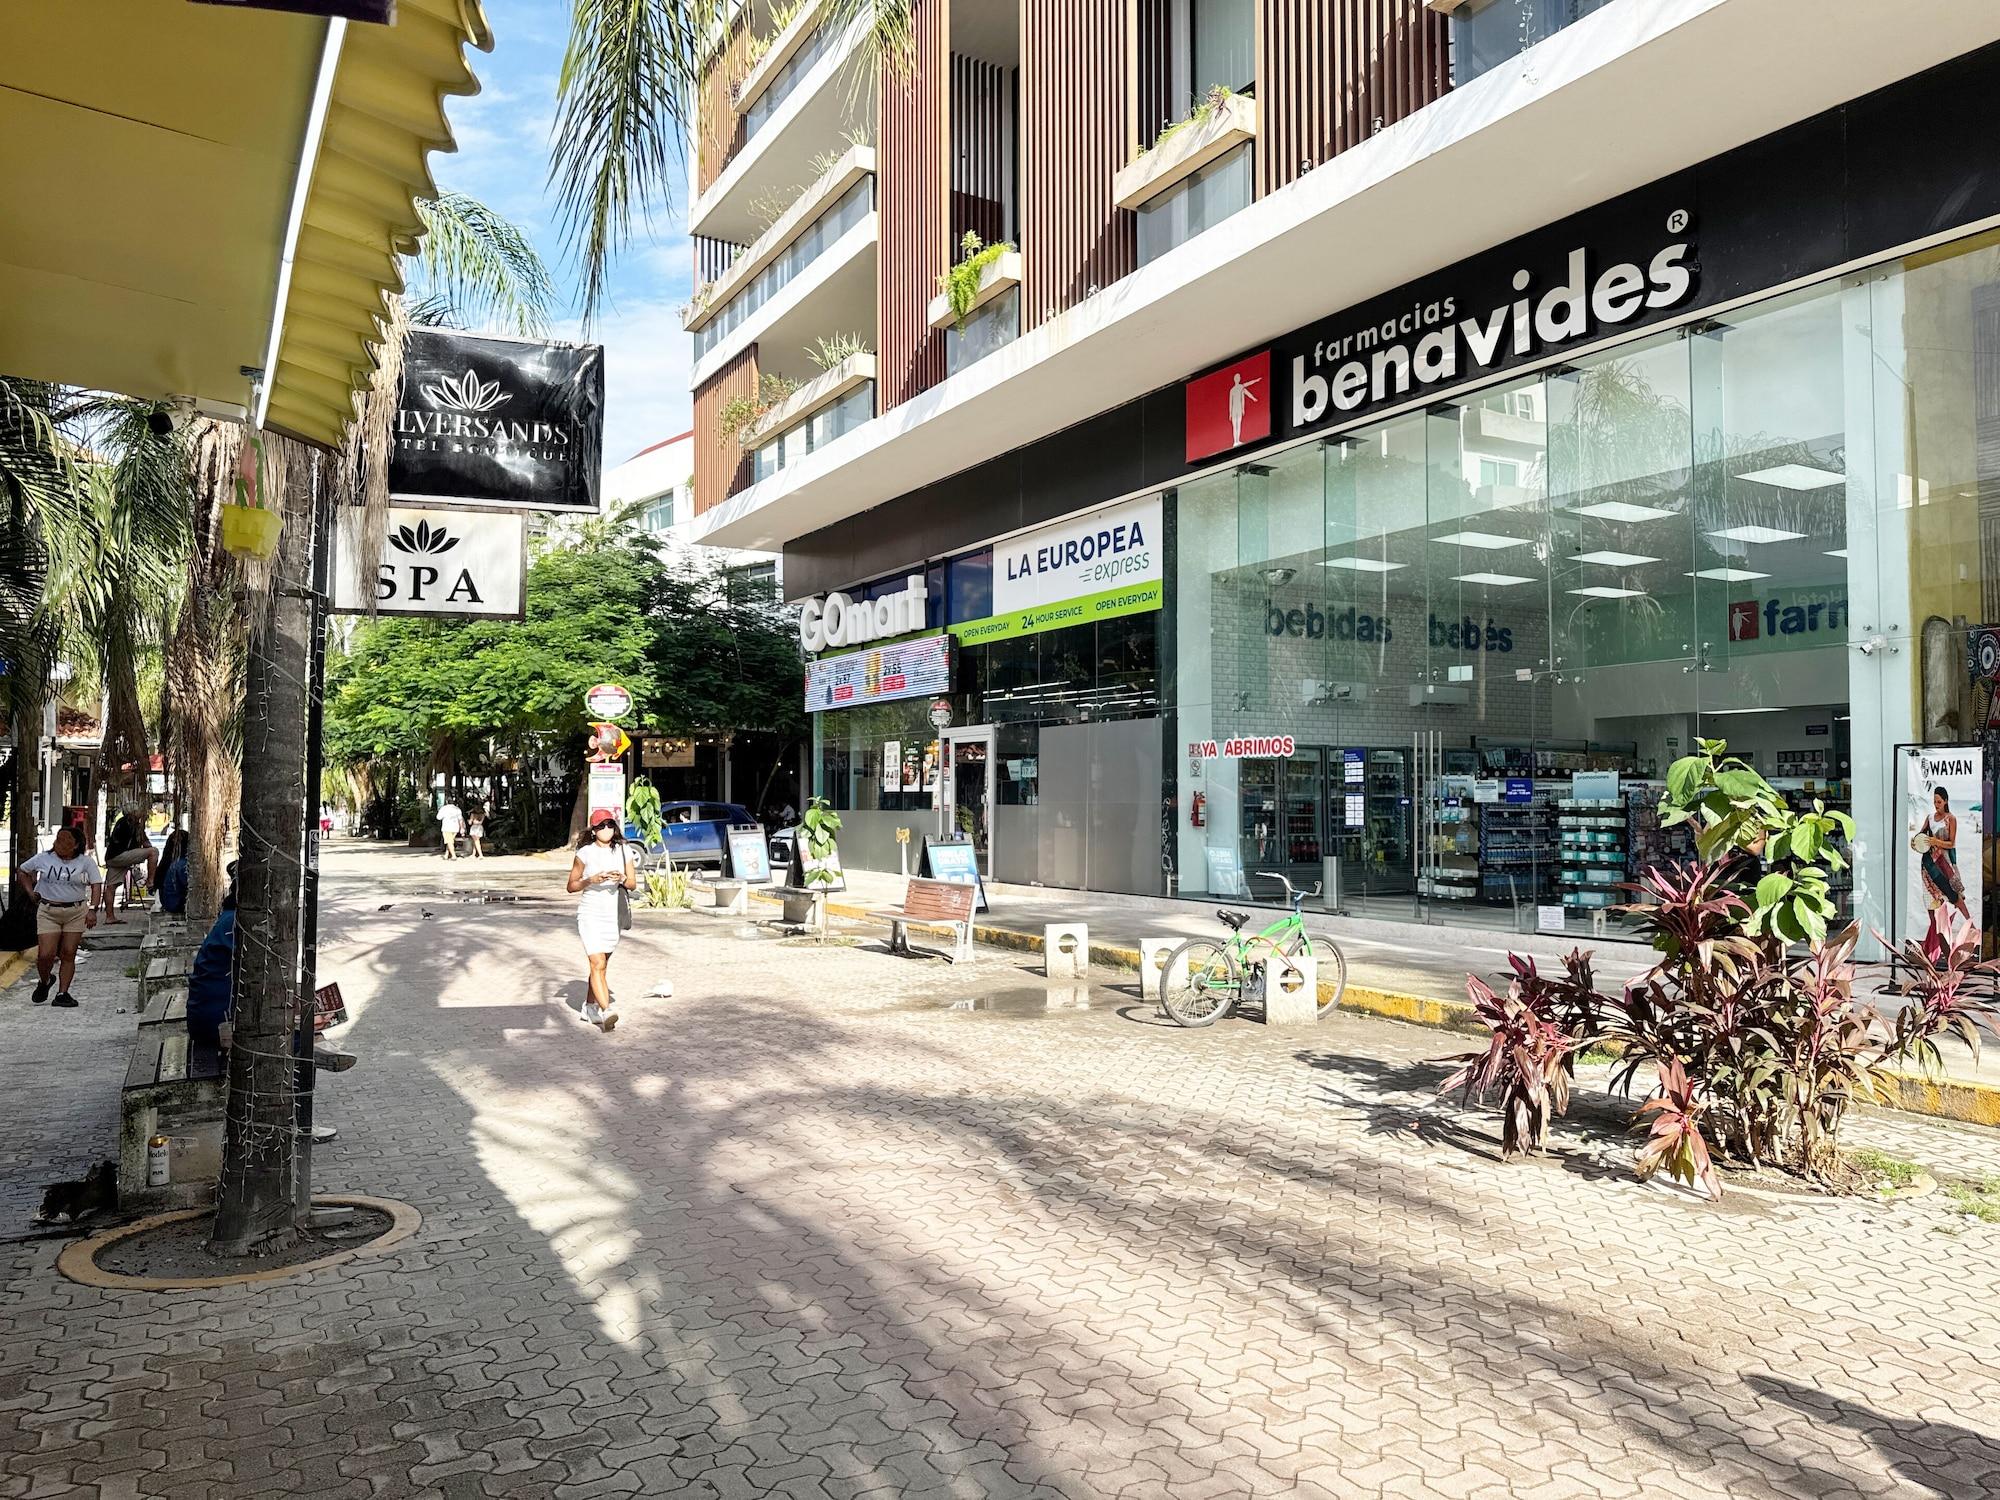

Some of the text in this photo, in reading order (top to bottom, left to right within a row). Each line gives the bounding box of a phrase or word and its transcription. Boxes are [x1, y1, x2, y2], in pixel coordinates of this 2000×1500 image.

[1292, 243, 1690, 428] benavides
[1314, 296, 1456, 367] farmacias
[1007, 521, 1145, 581] LA EUROPEA
[1094, 551, 1151, 583] express
[375, 563, 484, 604] SPA
[800, 574, 928, 653] GOmart
[963, 590, 1158, 638] OPEN EVERYDAY 24 HOUR SERVICE OPEN EVERYDAY
[1264, 598, 1393, 643] bebidas
[1428, 613, 1513, 653] bebés
[1201, 741, 1218, 758] YA
[1223, 737, 1294, 757] ABRIMOS
[1929, 760, 1972, 776] WAYAN
[47, 865, 77, 881] NY
